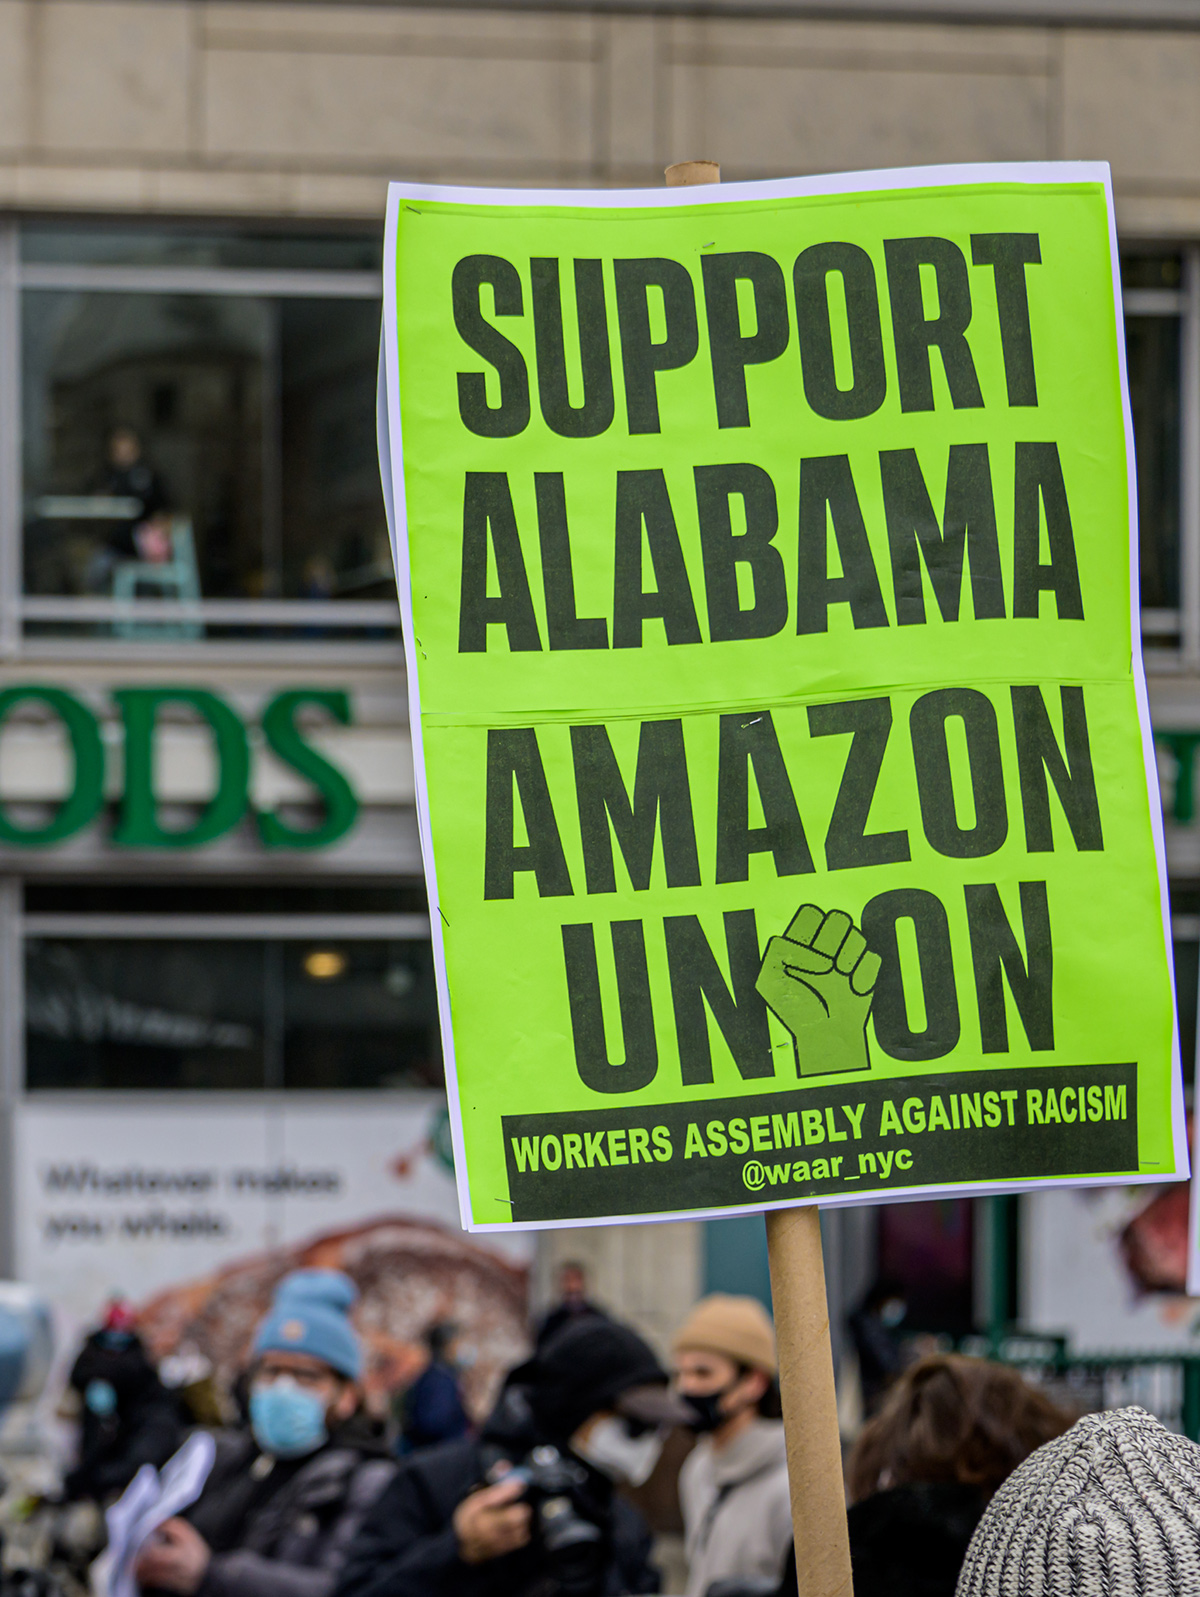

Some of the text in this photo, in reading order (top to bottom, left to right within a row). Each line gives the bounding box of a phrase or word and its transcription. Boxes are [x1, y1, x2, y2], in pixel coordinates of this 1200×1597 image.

[451, 232, 1042, 438] SUPPORT
[458, 441, 1084, 653] ALABAMA
[484, 685, 1104, 900] AMAZON
[512, 1085, 1128, 1172] WORKERS ASSEMBLY AGAINST RACISM
[742, 1147, 914, 1191] @waar_nyc
